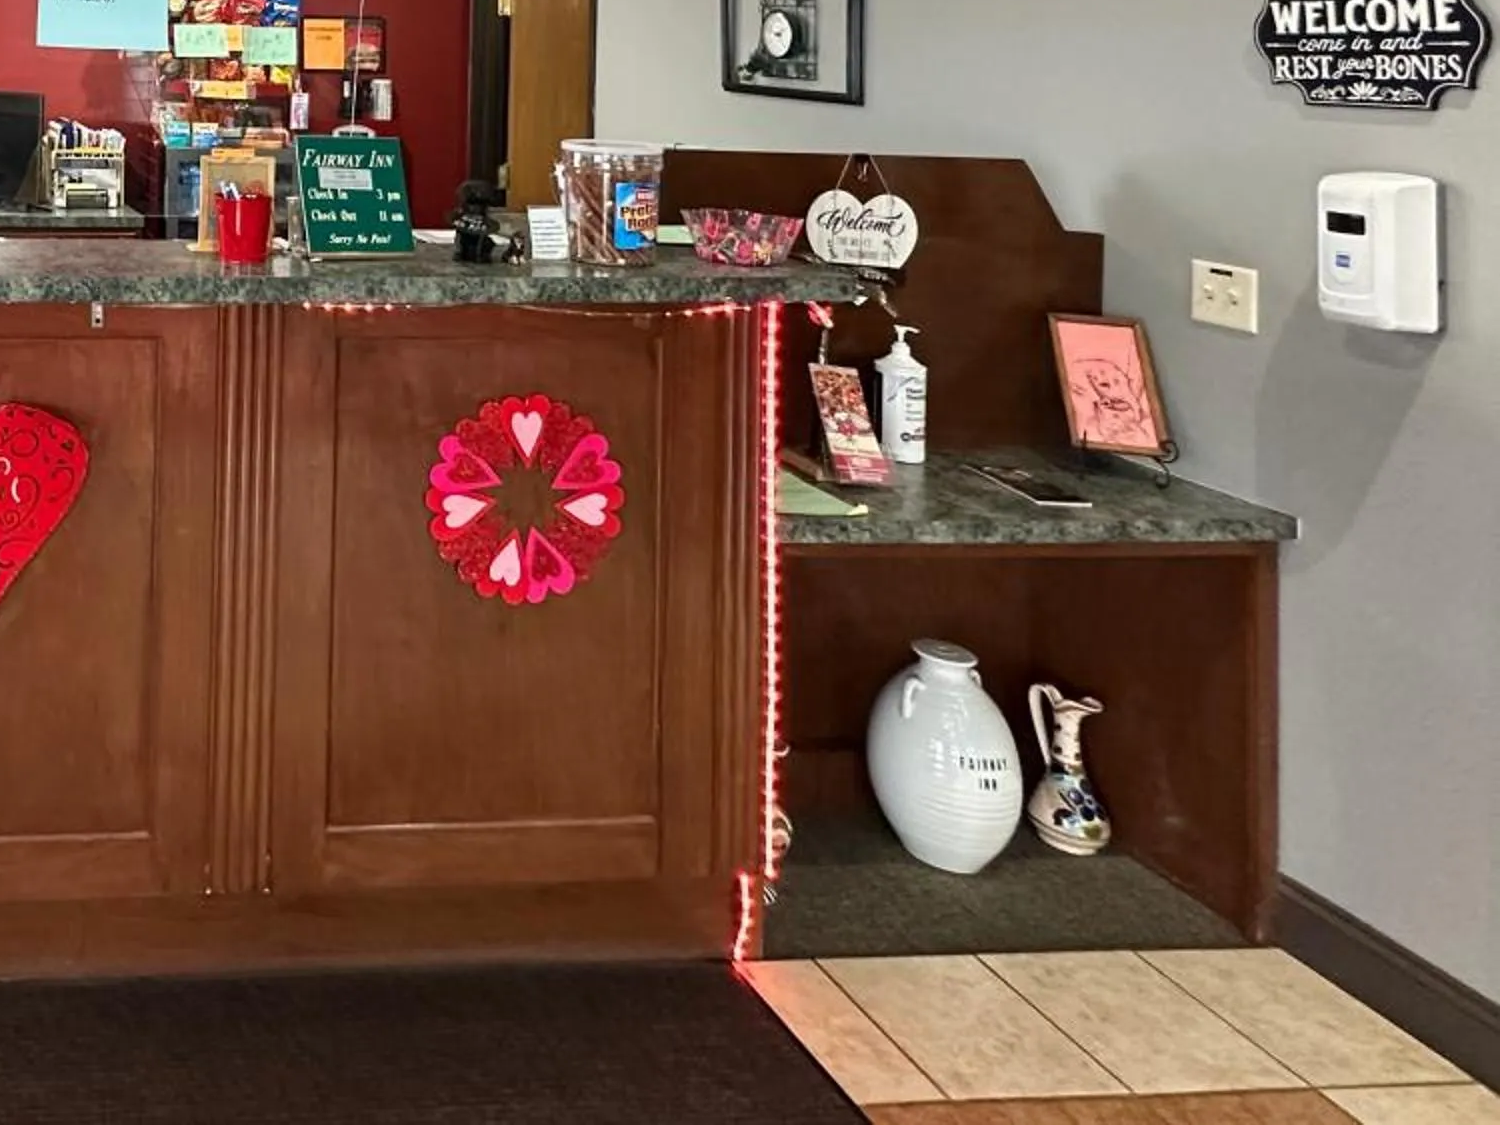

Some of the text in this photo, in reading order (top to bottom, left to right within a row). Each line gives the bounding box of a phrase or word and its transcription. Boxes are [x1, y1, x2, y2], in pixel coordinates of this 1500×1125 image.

[1297, 31, 1425, 52] come in and
[1274, 54, 1464, 81] REST your BONES
[302, 148, 395, 167] FAIRWAY INN
[307, 188, 334, 200] Check
[311, 209, 337, 222] Check
[340, 209, 357, 222] Out
[816, 207, 906, 237] Welcome
